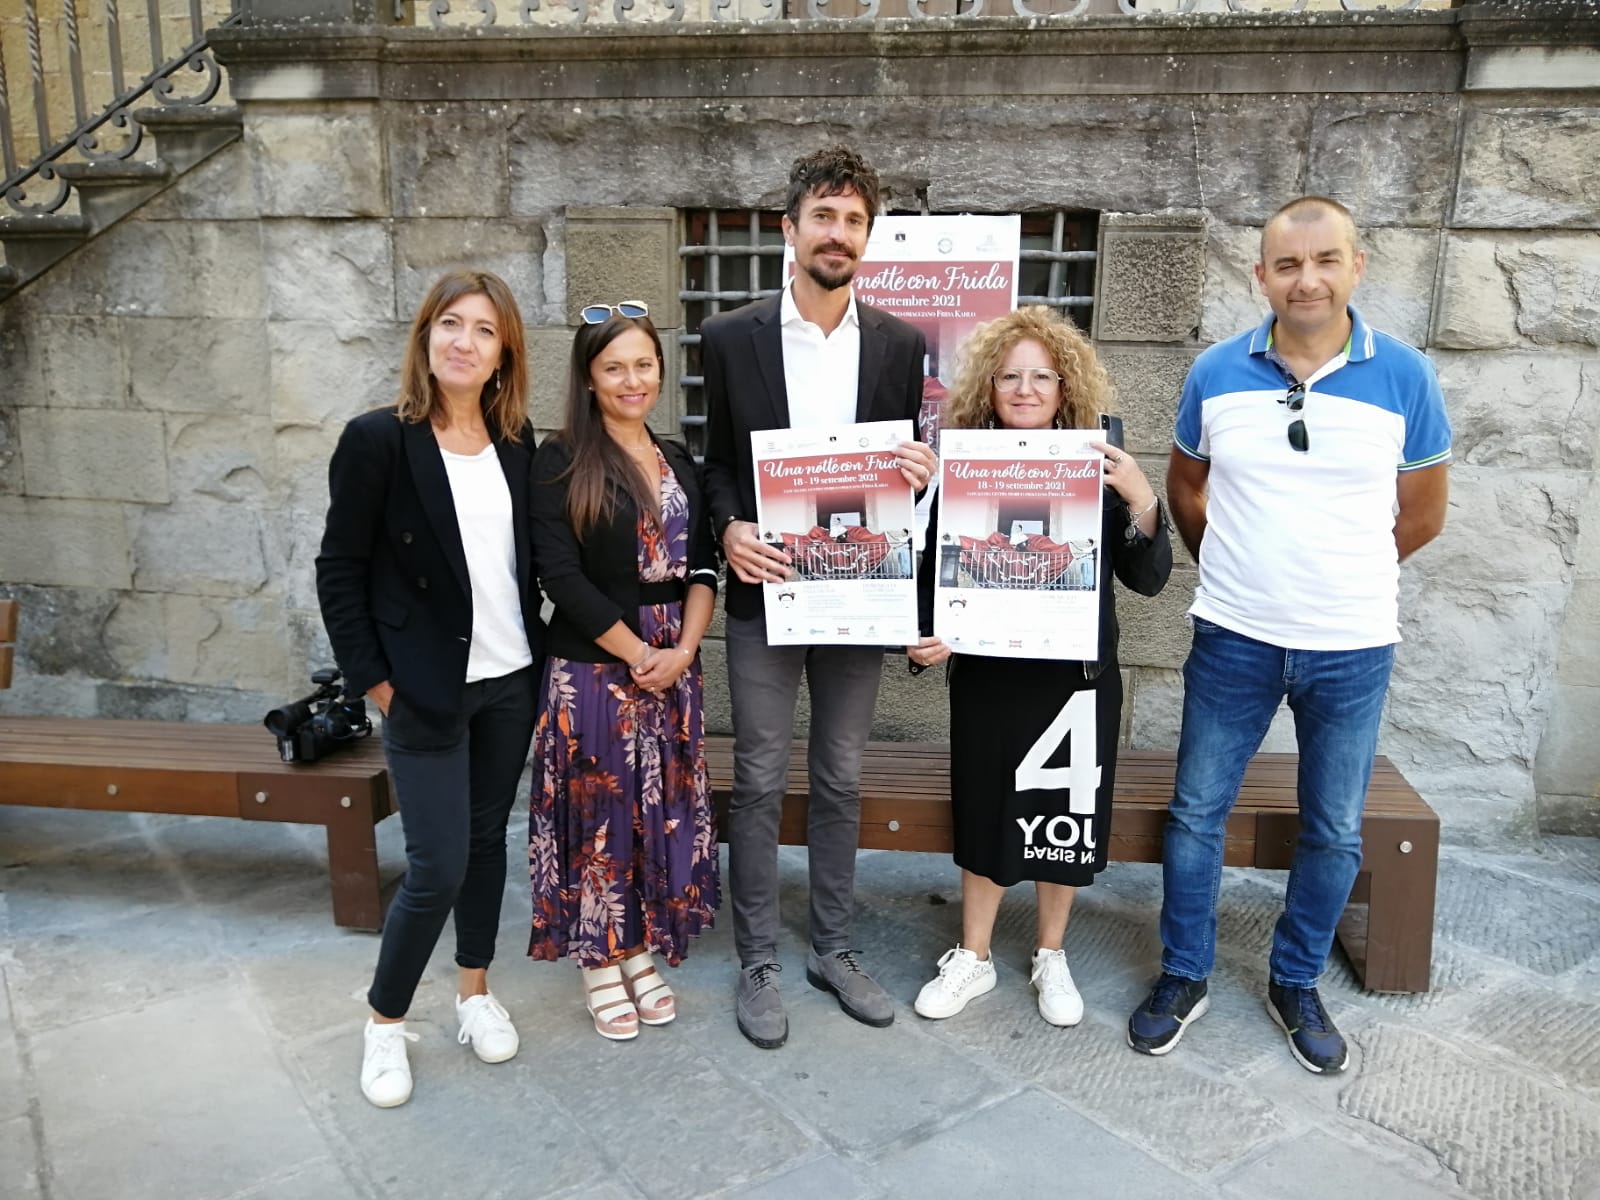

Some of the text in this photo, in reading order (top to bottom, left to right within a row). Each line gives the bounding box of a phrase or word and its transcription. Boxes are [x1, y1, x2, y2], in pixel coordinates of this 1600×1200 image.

[857, 266, 905, 291] notte
[907, 275, 941, 290] con
[943, 263, 1008, 291] Frida
[861, 294, 961, 306] 19 settembre 2021
[764, 455, 901, 478] Una notte con Frid
[950, 460, 1098, 480] Una notte con Frida
[793, 478, 804, 486] 18
[810, 476, 820, 485] 19
[821, 475, 857, 484] settembre
[858, 473, 878, 482] 2021
[977, 481, 987, 489] 18
[995, 481, 1004, 489] 19
[1006, 481, 1043, 489] settembre
[1045, 481, 1065, 489] 2021
[1015, 689, 1102, 815] 4
